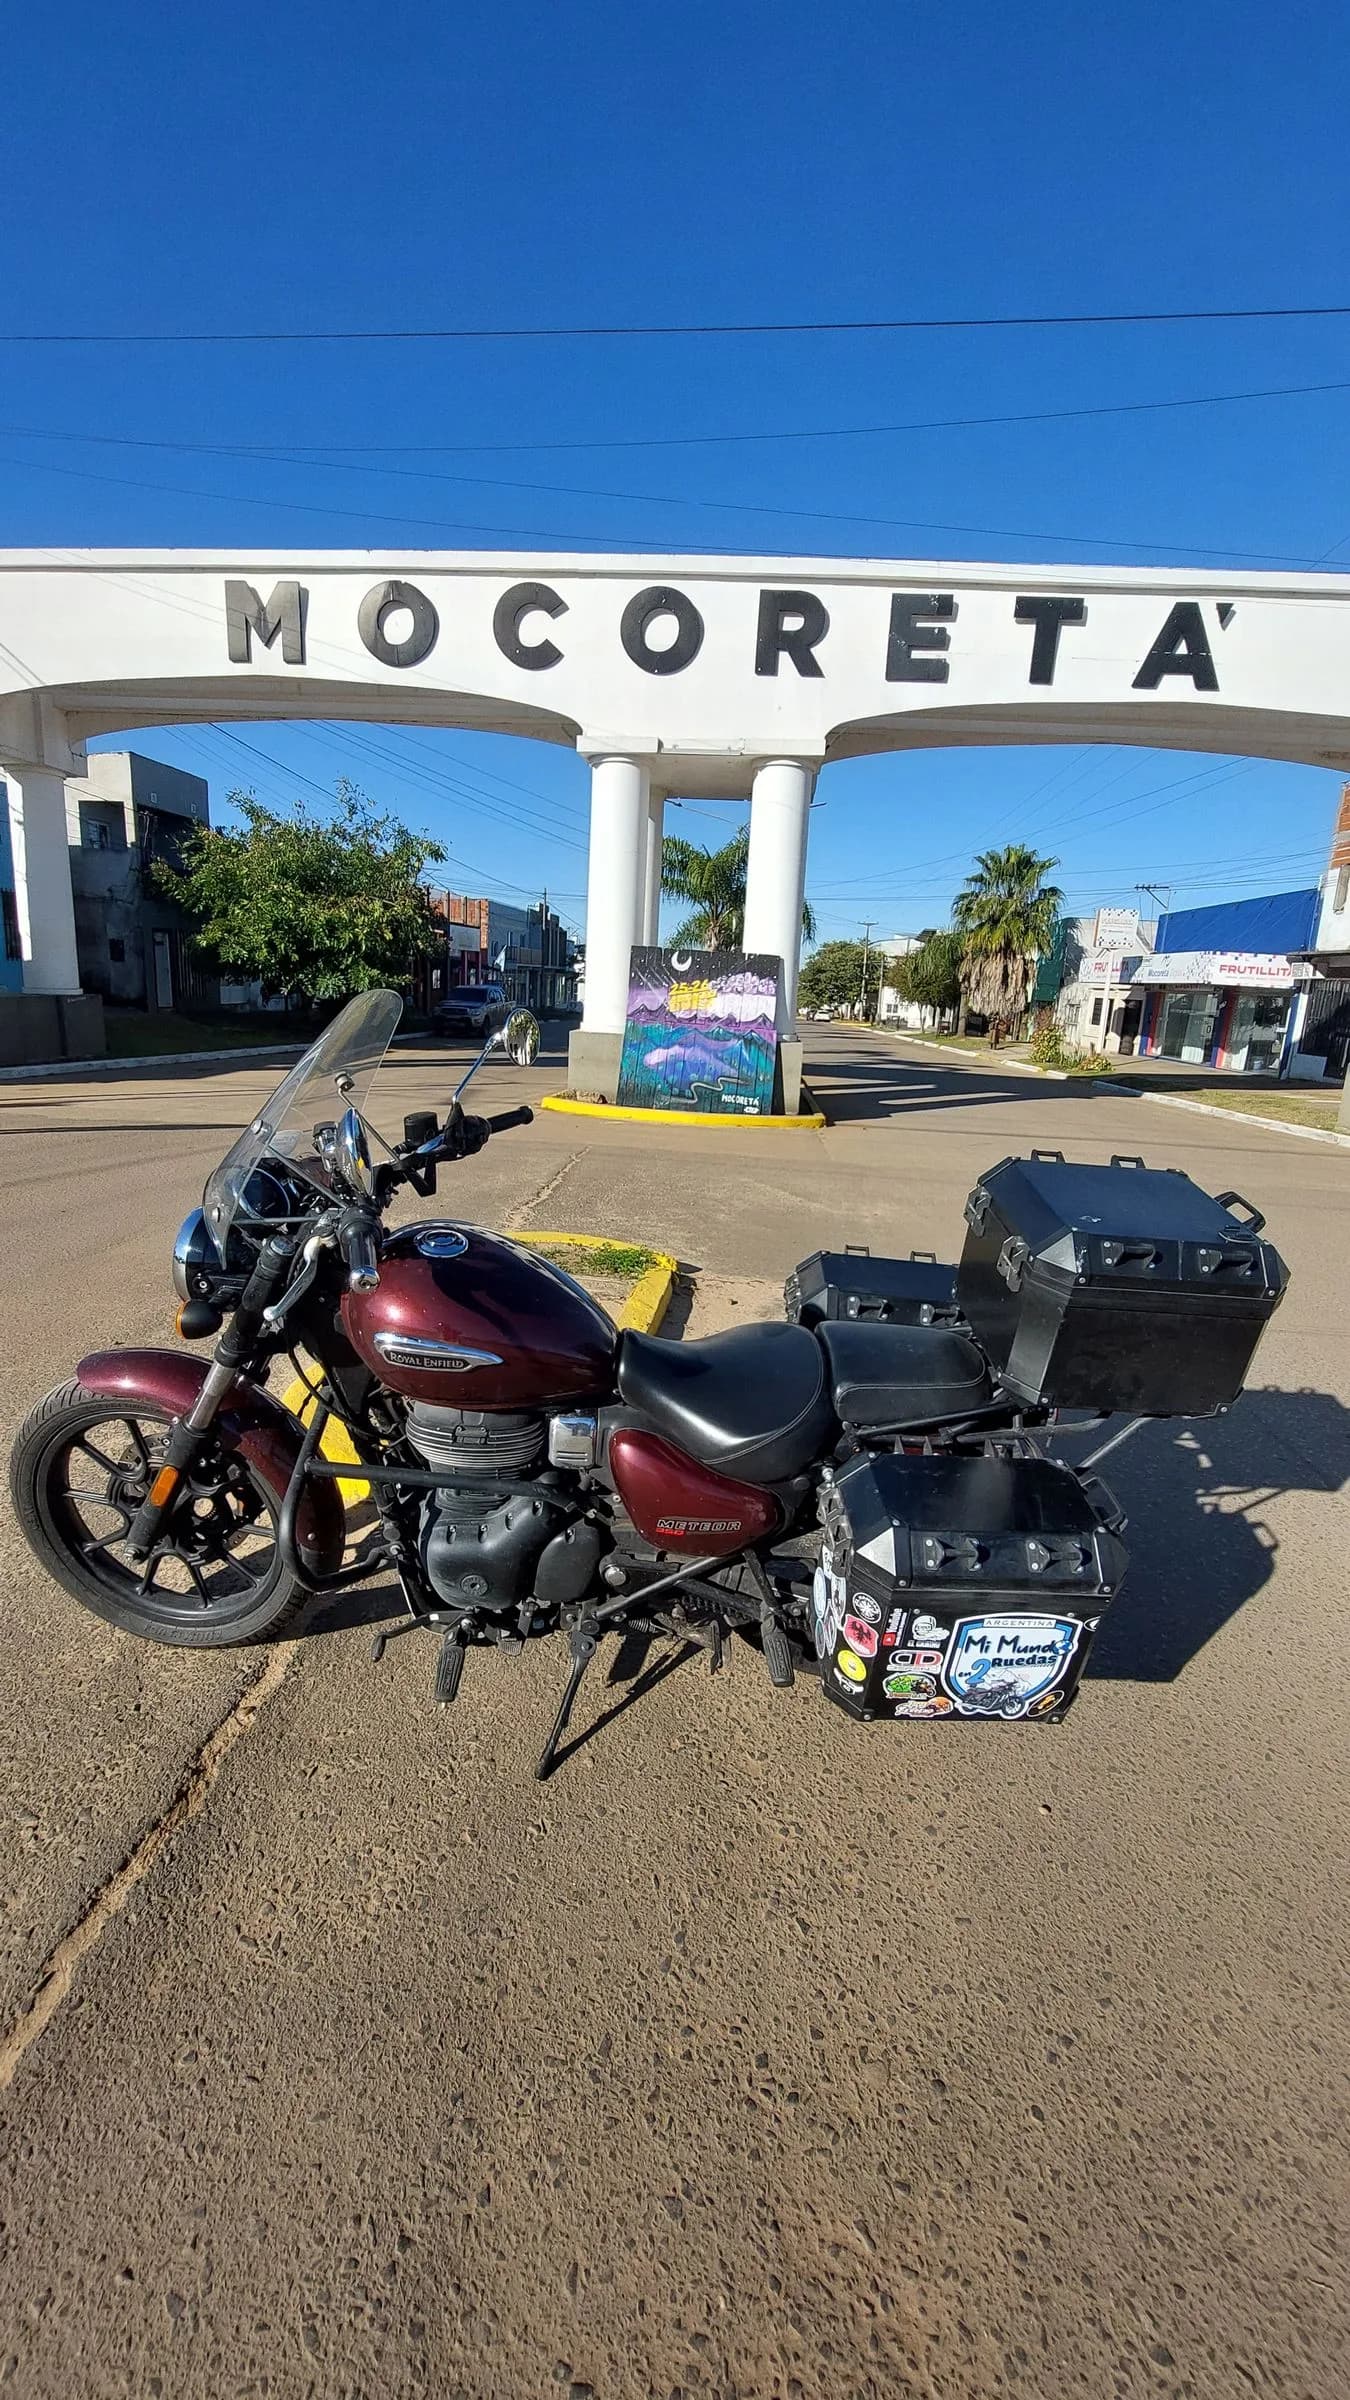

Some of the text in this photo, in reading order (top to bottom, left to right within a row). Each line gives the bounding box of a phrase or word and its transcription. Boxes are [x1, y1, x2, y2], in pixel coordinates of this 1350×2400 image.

[390, 1351, 465, 1369] ROYAL ENFIELD
[657, 1519, 741, 1532] METEOR
[984, 1619, 1054, 1627] ARGENTINA
[964, 1634, 992, 1654] Mi
[964, 1658, 992, 1685] 2
[991, 1654, 1057, 1668] Ruedas
